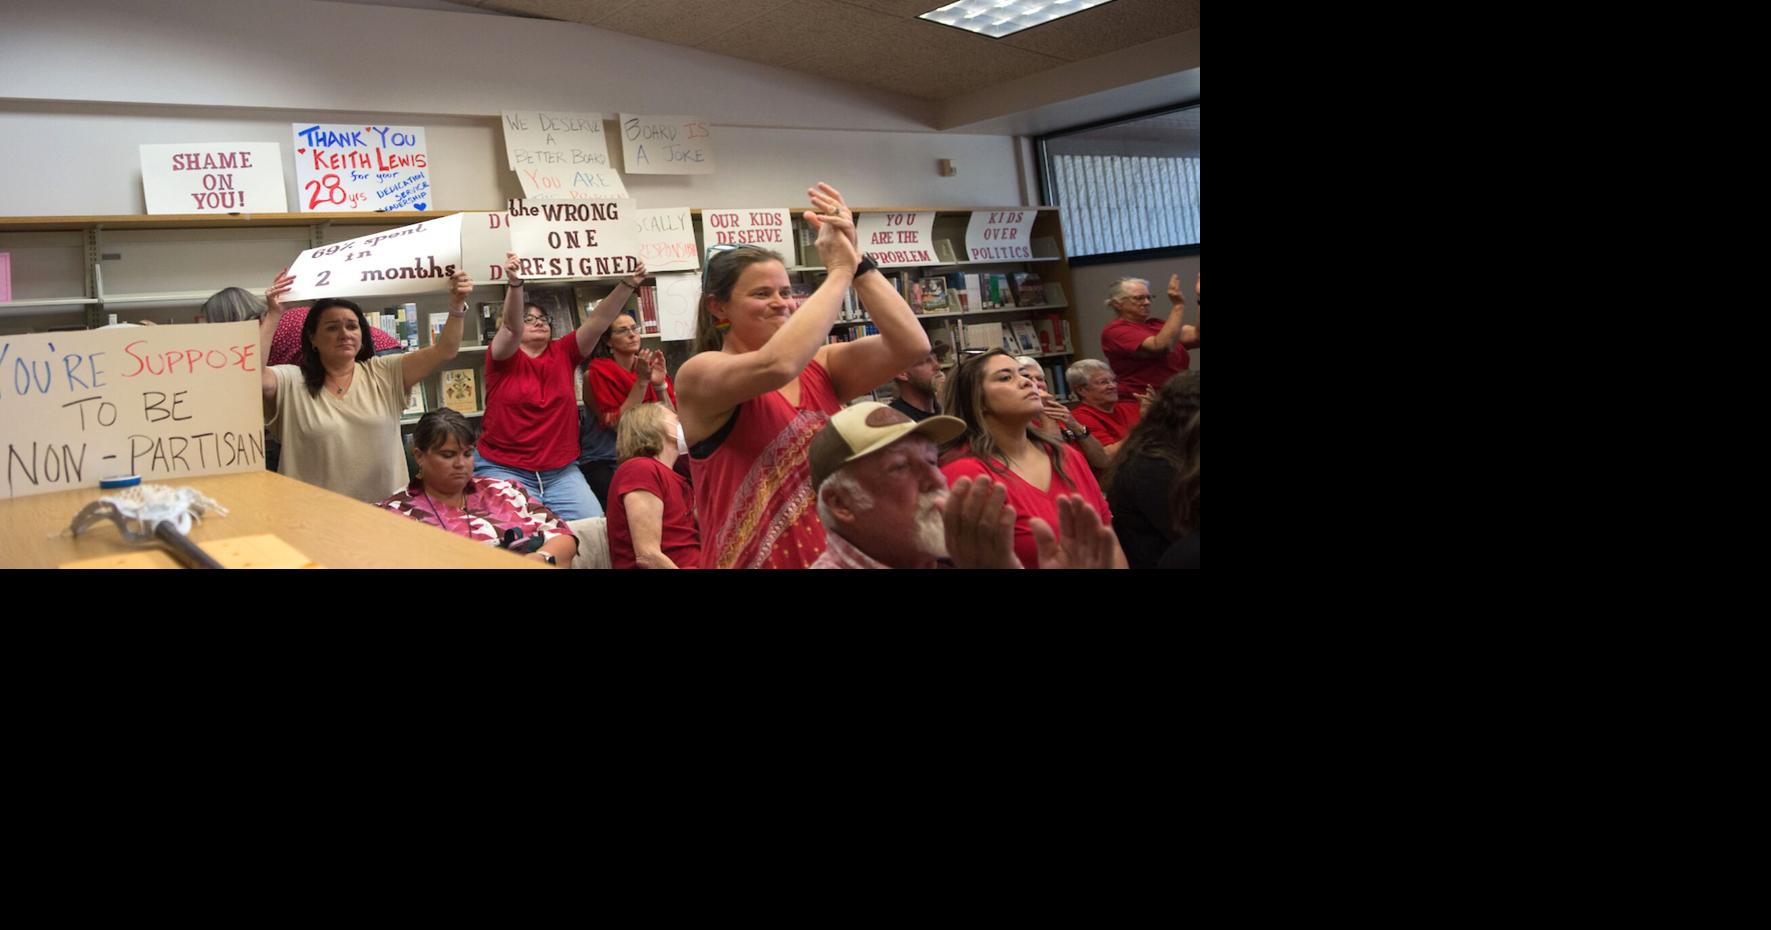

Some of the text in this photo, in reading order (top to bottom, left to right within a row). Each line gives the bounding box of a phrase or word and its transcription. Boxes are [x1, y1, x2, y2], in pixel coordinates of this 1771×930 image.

[506, 112, 601, 133] WE DESERVE
[624, 118, 710, 141] BOARD IS
[298, 125, 416, 149] THANK YOU
[546, 133, 557, 145] A
[172, 152, 253, 171] SHAME
[312, 147, 427, 171] KEITH LEWIS
[514, 149, 607, 165] BETTER BOARD
[637, 144, 705, 167] A JOKE
[202, 174, 234, 191] ON
[376, 171, 399, 184] your
[524, 168, 609, 191] YOU ARE
[191, 191, 245, 210] YOU!
[304, 173, 368, 210] 28 yrs
[509, 199, 619, 222] the WRONG
[710, 212, 783, 228] OUR KIDS
[886, 213, 916, 227] YOU
[988, 212, 1024, 225] KIDS
[311, 223, 427, 260] 69% spent
[548, 229, 598, 249] ONE
[716, 228, 783, 245] DESERVE
[871, 230, 919, 245] ARE THE
[983, 228, 1017, 240] OVER
[344, 249, 372, 262] in
[871, 249, 931, 264] PROBLEM
[971, 246, 1030, 260] POLITICS
[314, 255, 456, 287] 2 months
[520, 256, 638, 276] RESIGNED
[121, 340, 256, 377] SUPPOSE
[62, 390, 192, 431] TO BE
